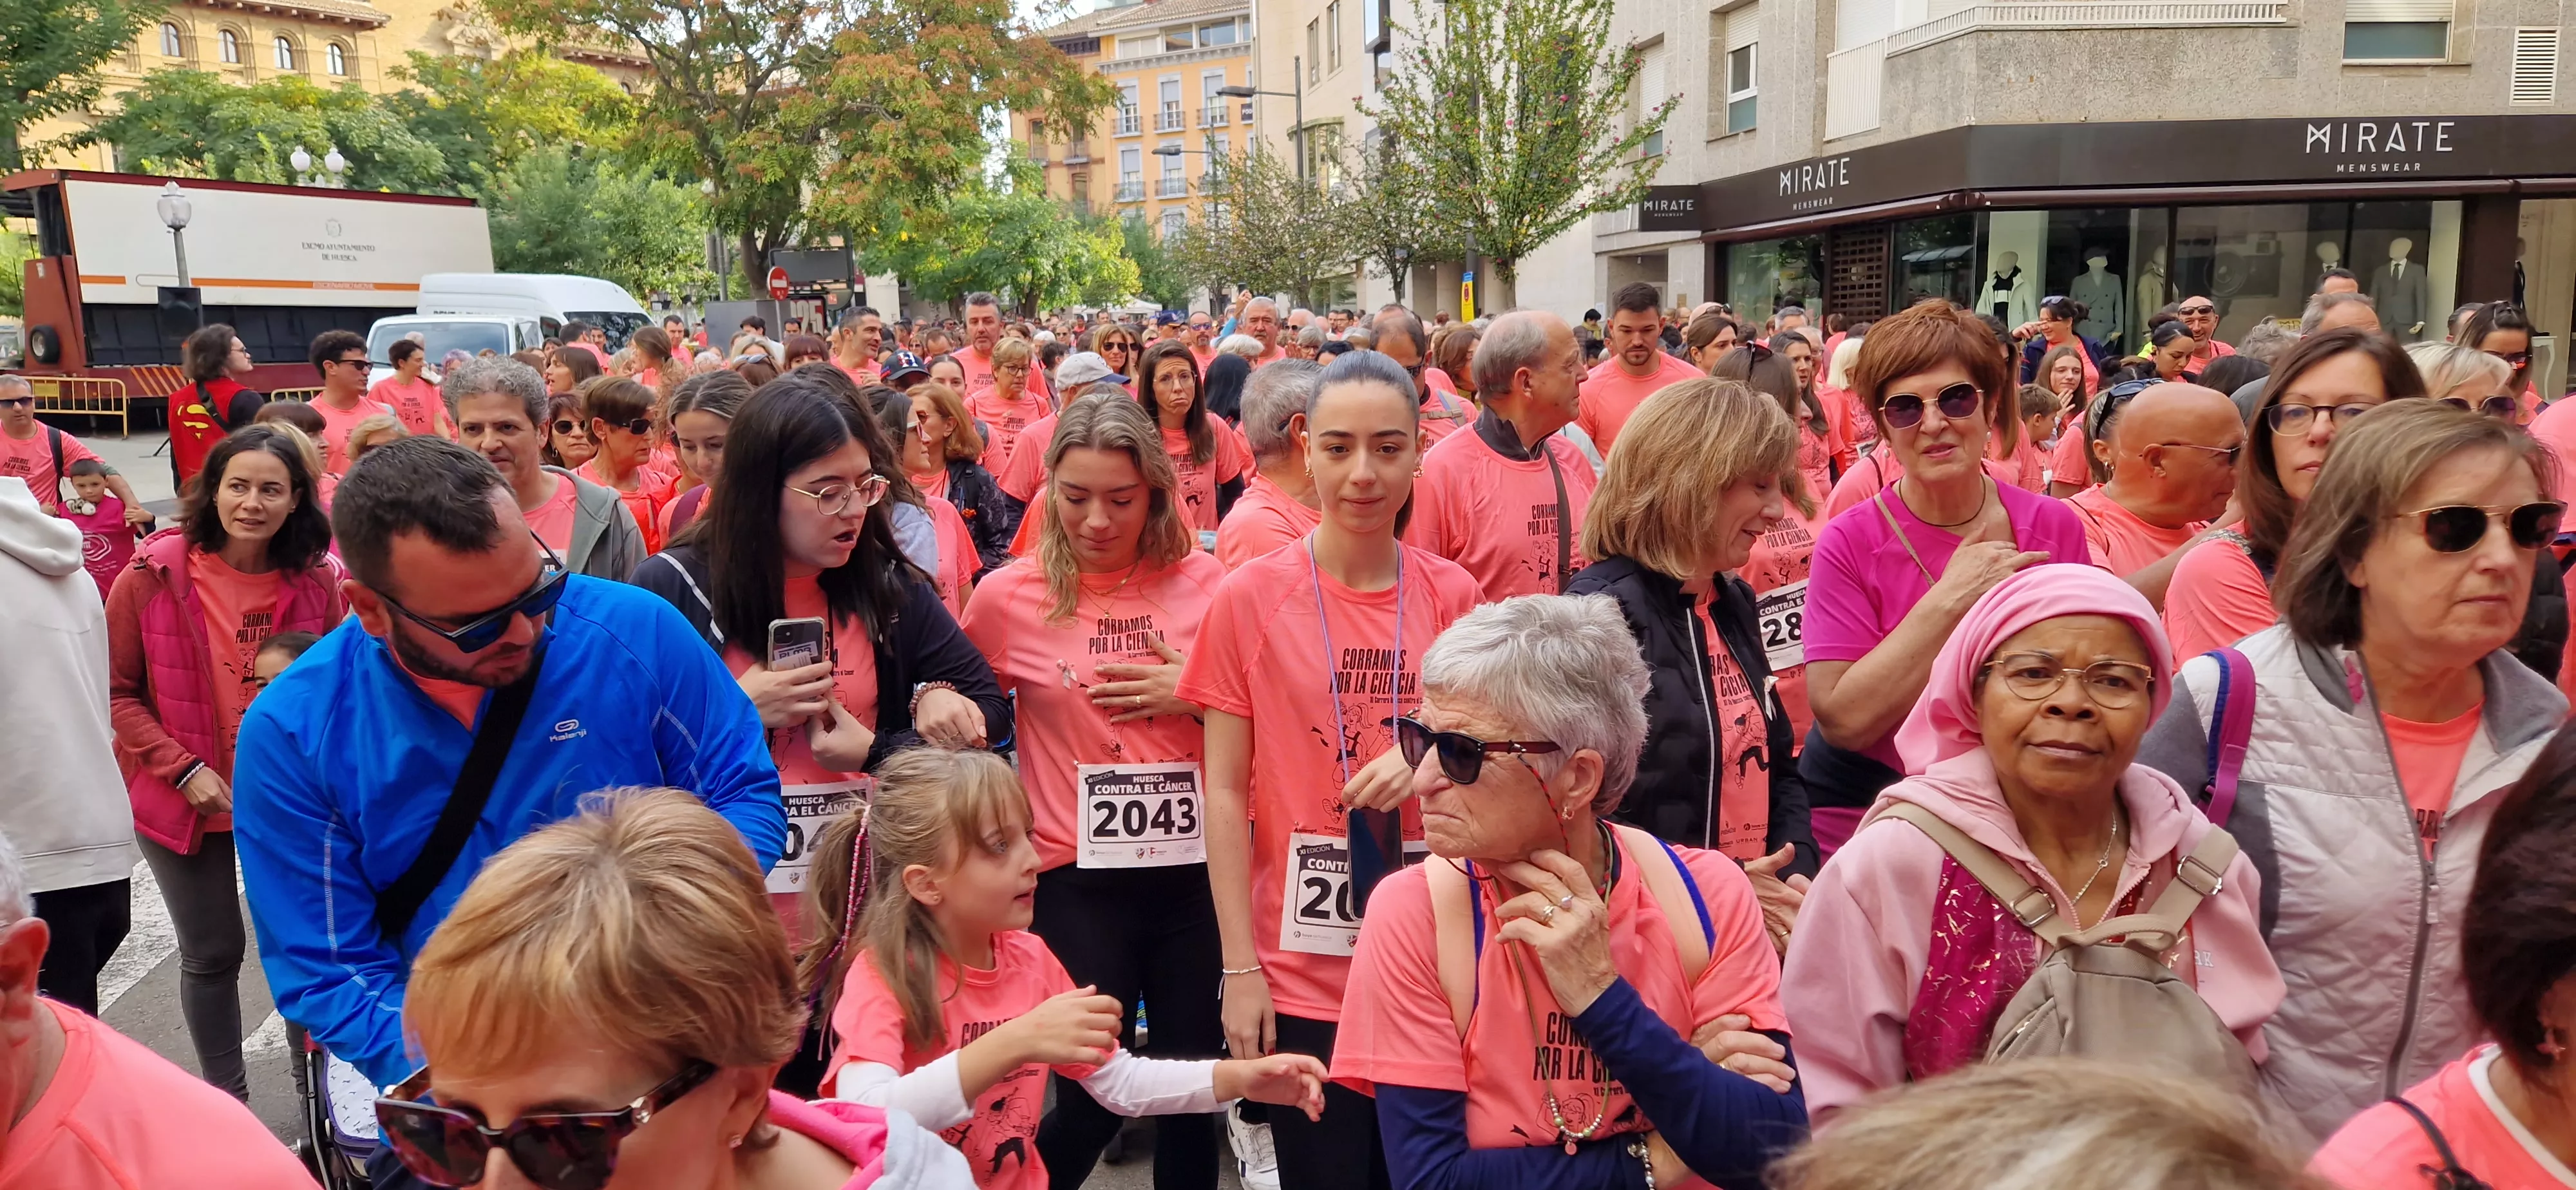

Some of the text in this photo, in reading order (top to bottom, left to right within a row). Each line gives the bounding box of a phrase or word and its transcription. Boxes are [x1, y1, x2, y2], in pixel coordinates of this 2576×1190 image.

[2306, 122, 2455, 153] MIRATE
[2336, 163, 2421, 173] MENSWEAR
[1779, 157, 1850, 196] MIRATE
[1643, 200, 1694, 211] MIRATE
[1793, 197, 1833, 211] MENSWEAR
[326, 243, 375, 252] AYUNTAMIENTO
[1528, 520, 1540, 536] POR
[1542, 519, 1549, 534] LA
[1765, 534, 1779, 549] POR
[1777, 532, 1787, 546] LA
[1785, 528, 1812, 545] CIENCIA
[1759, 600, 1795, 616] CONTRA
[1097, 614, 1153, 636] CORRAMOS
[1762, 612, 1802, 648] 28
[236, 628, 249, 644] POR
[1089, 637, 1108, 655] POR
[1112, 636, 1122, 652] LA
[1354, 672, 1367, 694] LA
[549, 729, 587, 742] Kalenji
[1095, 780, 1192, 794] CONTRA EL CÁNCER
[1133, 775, 1164, 783] HUESCA
[789, 796, 825, 805] HUESCA
[802, 806, 815, 816] EL
[1092, 797, 1197, 837] 2043
[1307, 845, 1331, 854] EDICIÓN
[1568, 1049, 1586, 1081] LA
